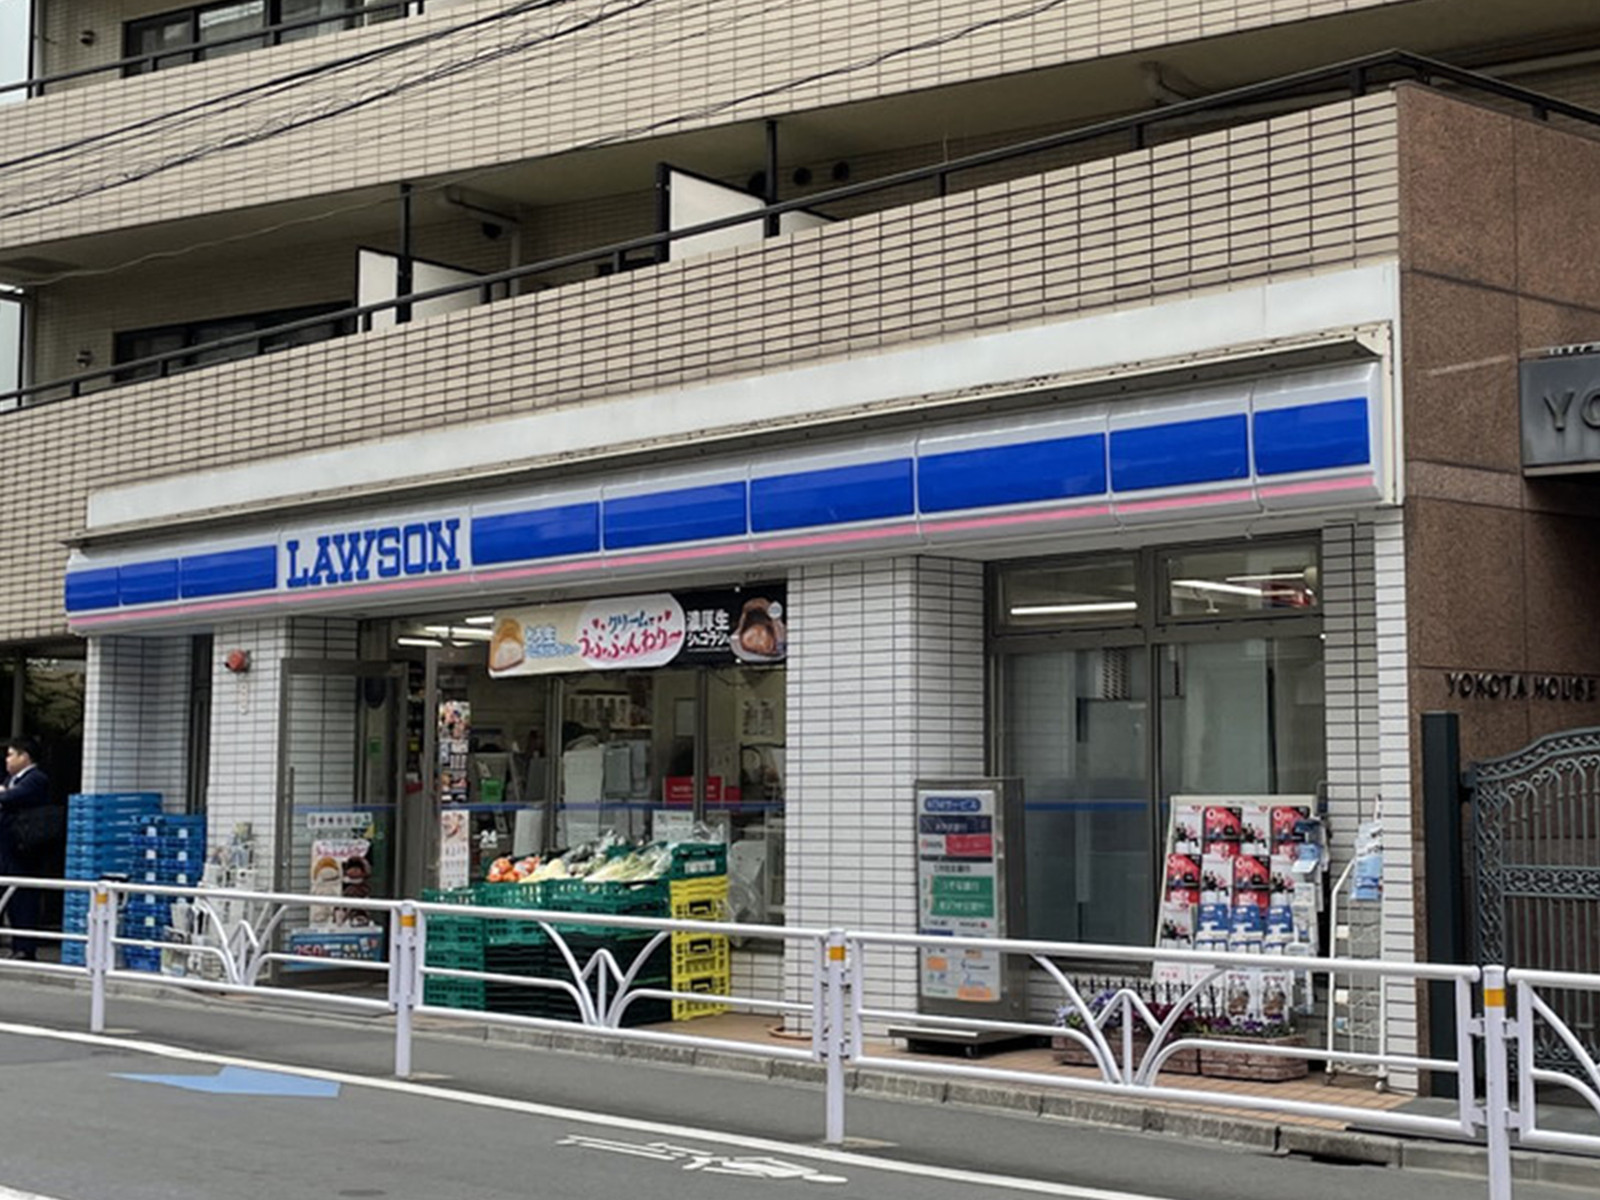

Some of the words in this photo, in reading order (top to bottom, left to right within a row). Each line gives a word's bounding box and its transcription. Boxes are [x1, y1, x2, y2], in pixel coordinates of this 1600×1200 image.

[287, 518, 460, 588] LAWSON
[1444, 672, 1528, 700] YOKOTA
[1531, 676, 1597, 701] HOUSE
